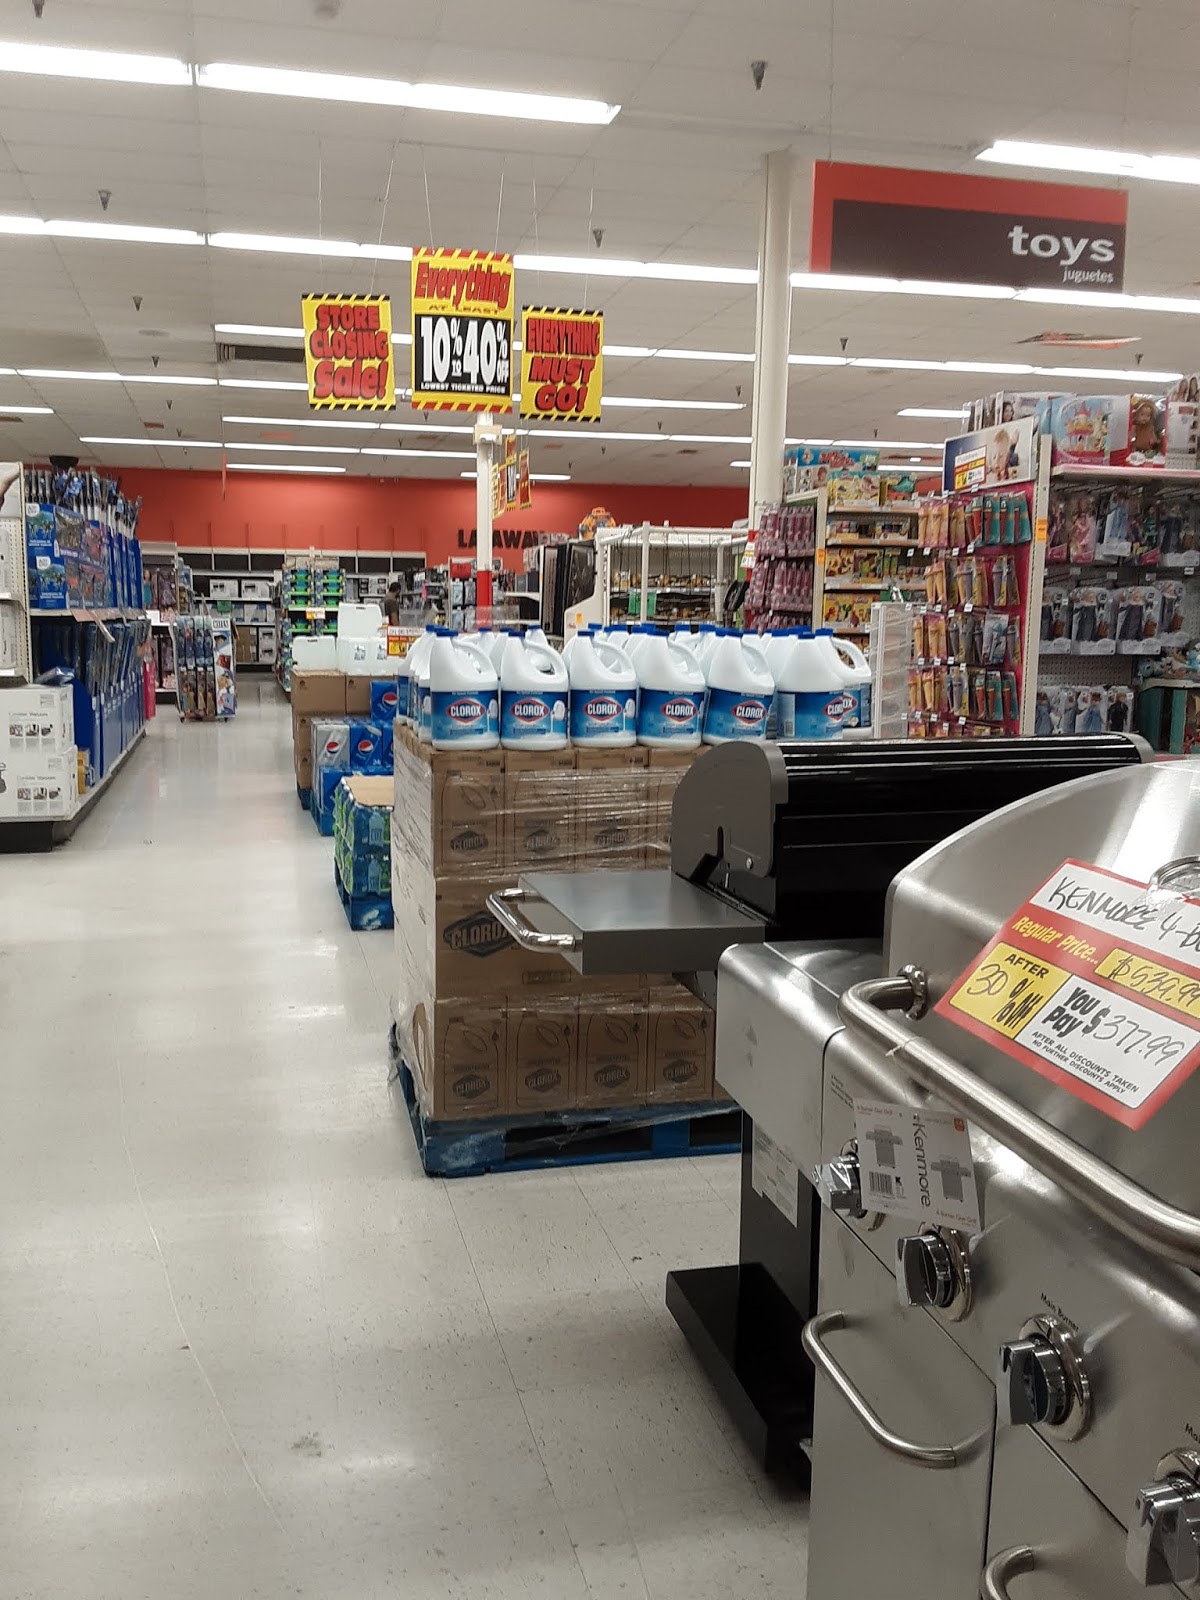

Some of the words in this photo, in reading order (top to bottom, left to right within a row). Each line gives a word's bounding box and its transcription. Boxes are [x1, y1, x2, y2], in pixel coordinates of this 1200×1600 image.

[1007, 225, 1115, 267] toys
[414, 262, 512, 311] Everything
[1062, 267, 1114, 284] juguetes
[316, 304, 380, 332] STORE
[309, 330, 389, 360] CLOSING
[526, 317, 600, 357] EVERYTHING
[313, 359, 389, 400] Sale!
[528, 356, 596, 386] MUST
[535, 384, 588, 413] GO!
[458, 529, 544, 549] LAAWA
[450, 705, 481, 717] CLOROX
[514, 704, 545, 717] CLOROX
[587, 703, 618, 716] CLOROX
[665, 704, 694, 716] CLOROX
[735, 706, 764, 718] CLOROX
[1012, 916, 1063, 944] Regular
[1056, 935, 1098, 965] Price...
[1158, 911, 1200, 952] 4-B
[967, 963, 1009, 996] 30
[1005, 953, 1049, 979] AFTER
[1063, 987, 1101, 1015] YOU
[1041, 1006, 1084, 1038] Pay
[1032, 1031, 1055, 1047] AFTER
[1054, 1043, 1069, 1055] ALL
[1069, 1051, 1111, 1078] DISCOUNTS
[1112, 1074, 1140, 1093] TAKEN
[1032, 1039, 1041, 1048] NO
[1042, 1045, 1069, 1063] FURTHER
[1069, 1060, 1105, 1083] DISCOUNTS
[1104, 1080, 1127, 1095] APPLY
[912, 1122, 931, 1208] Kenmore
